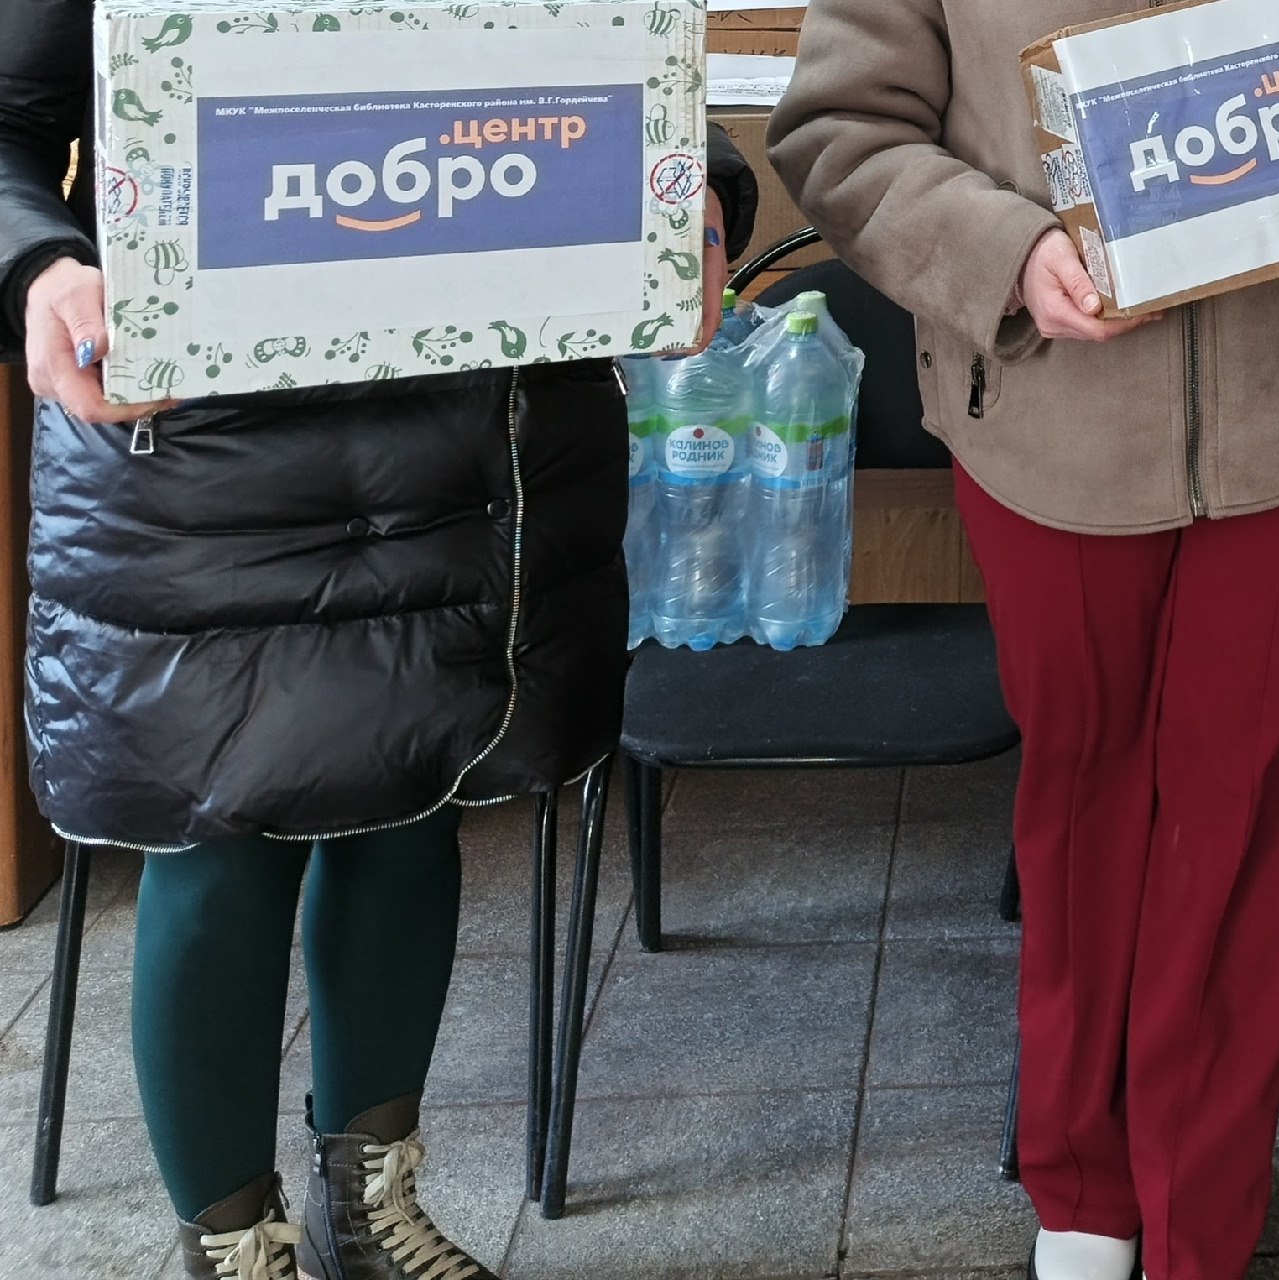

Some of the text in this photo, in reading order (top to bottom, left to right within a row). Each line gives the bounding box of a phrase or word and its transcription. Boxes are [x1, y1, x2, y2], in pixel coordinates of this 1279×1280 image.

[216, 108, 246, 116] МКУК
[353, 102, 411, 112] библиотека
[413, 100, 483, 109] Касторенского
[484, 98, 517, 108] района
[264, 137, 537, 221] добро
